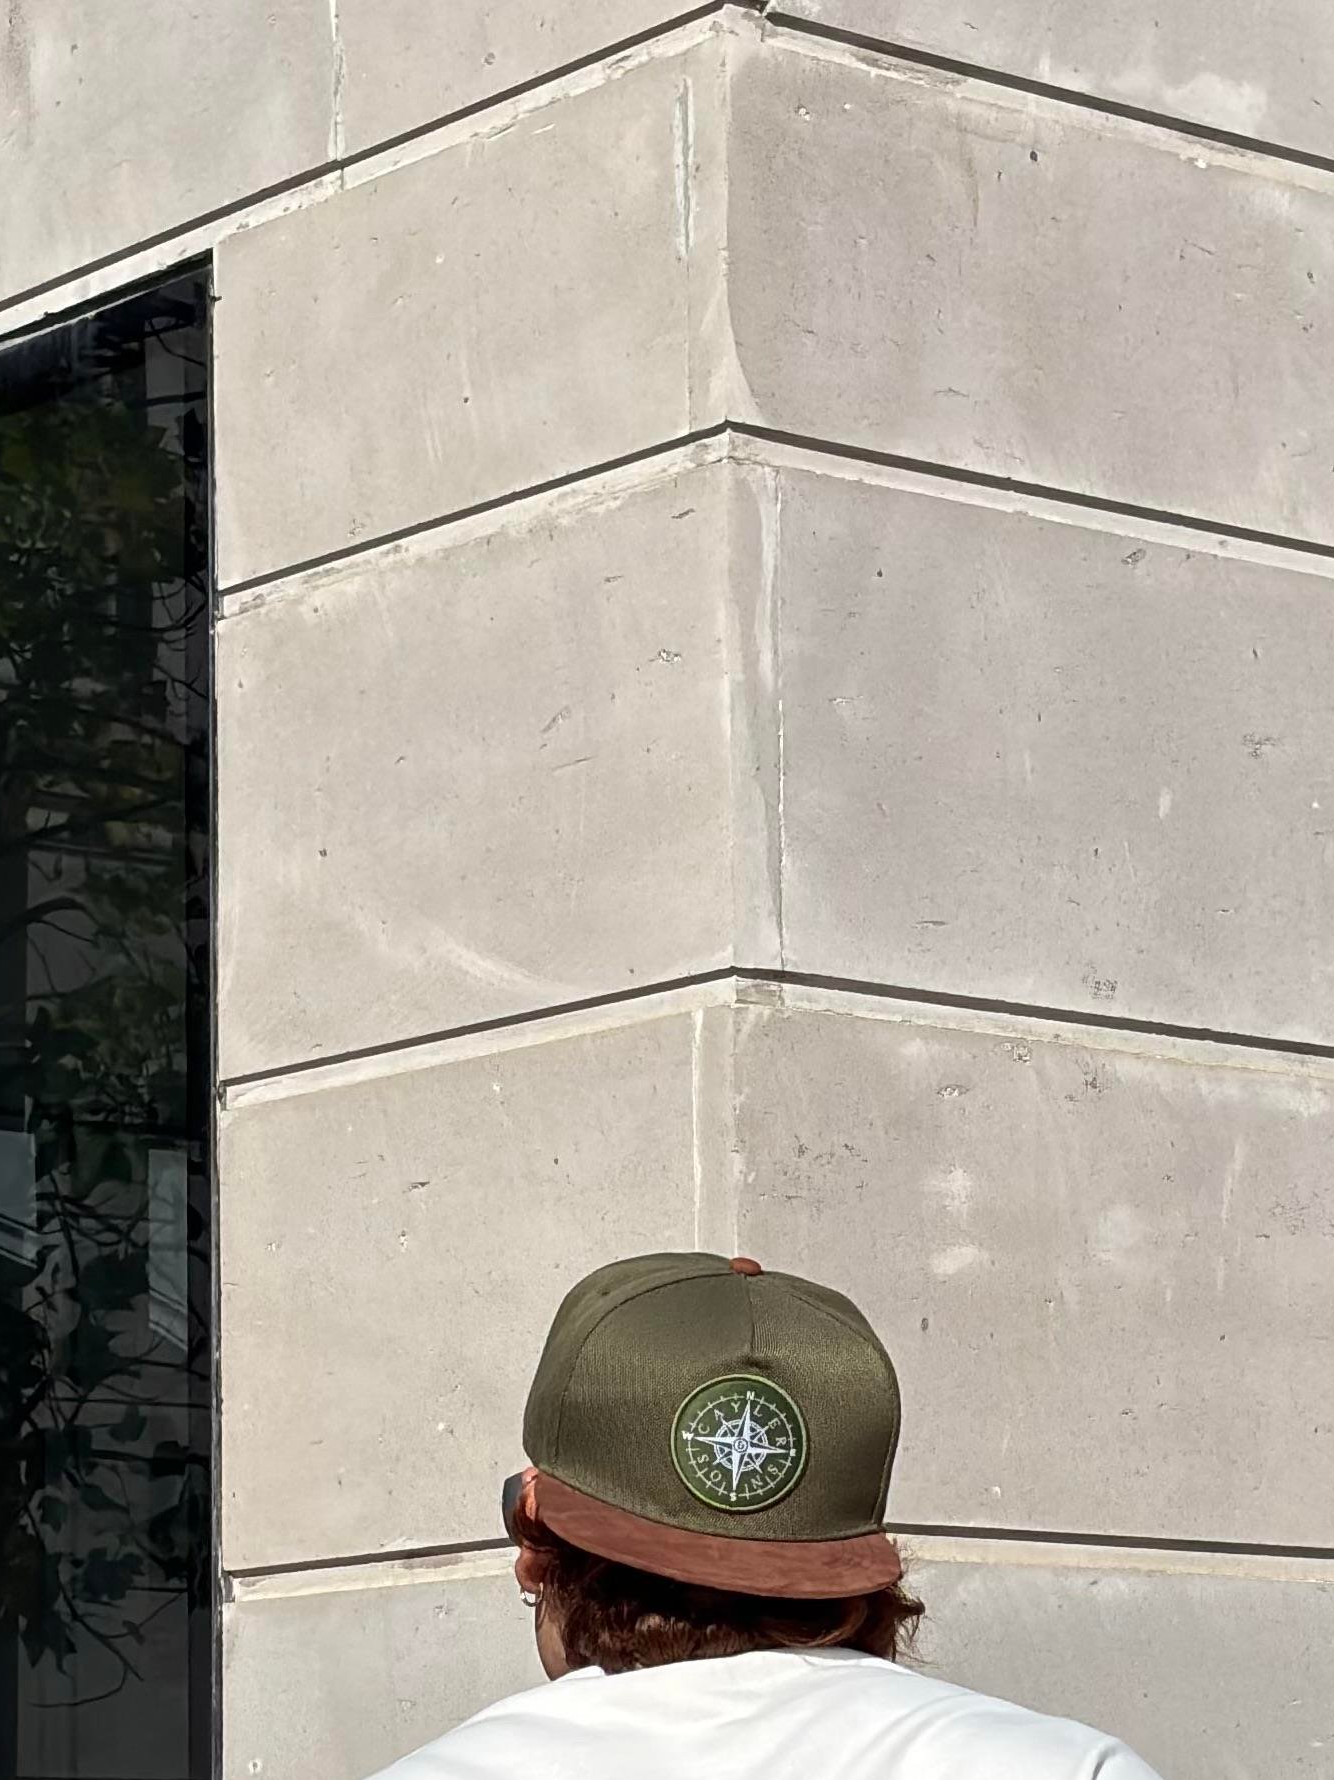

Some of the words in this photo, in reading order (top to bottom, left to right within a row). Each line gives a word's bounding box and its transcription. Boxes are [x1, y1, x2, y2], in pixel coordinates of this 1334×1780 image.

[746, 1391, 755, 1401] N
[697, 1401, 786, 1446] CAYLER
[682, 1430, 694, 1440] W
[697, 1454, 778, 1489] SONS
[730, 1492, 737, 1502] S
